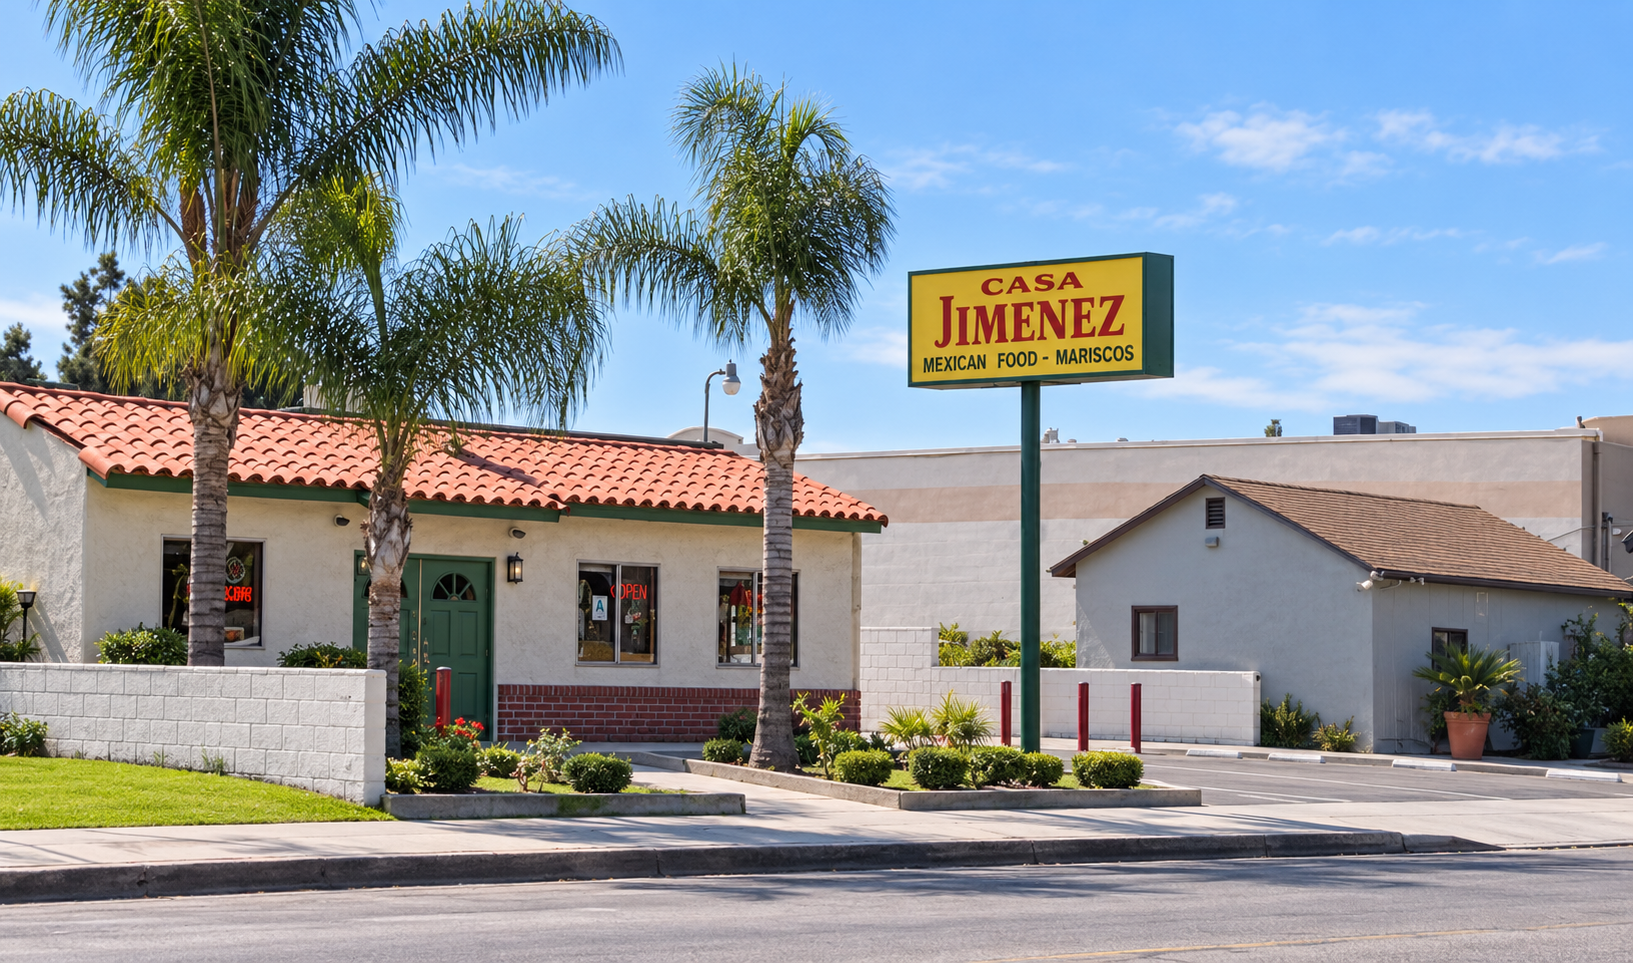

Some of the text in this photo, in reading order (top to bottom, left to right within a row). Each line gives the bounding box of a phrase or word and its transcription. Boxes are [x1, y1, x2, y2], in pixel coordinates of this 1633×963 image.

[981, 271, 1084, 296] CASA
[934, 294, 1125, 349] JIMENEZ
[923, 354, 987, 373] MEXICAN
[997, 350, 1038, 369] FOOD
[1056, 344, 1135, 365] MARISCOS
[610, 584, 647, 599] OPEN
[596, 599, 604, 612] A
